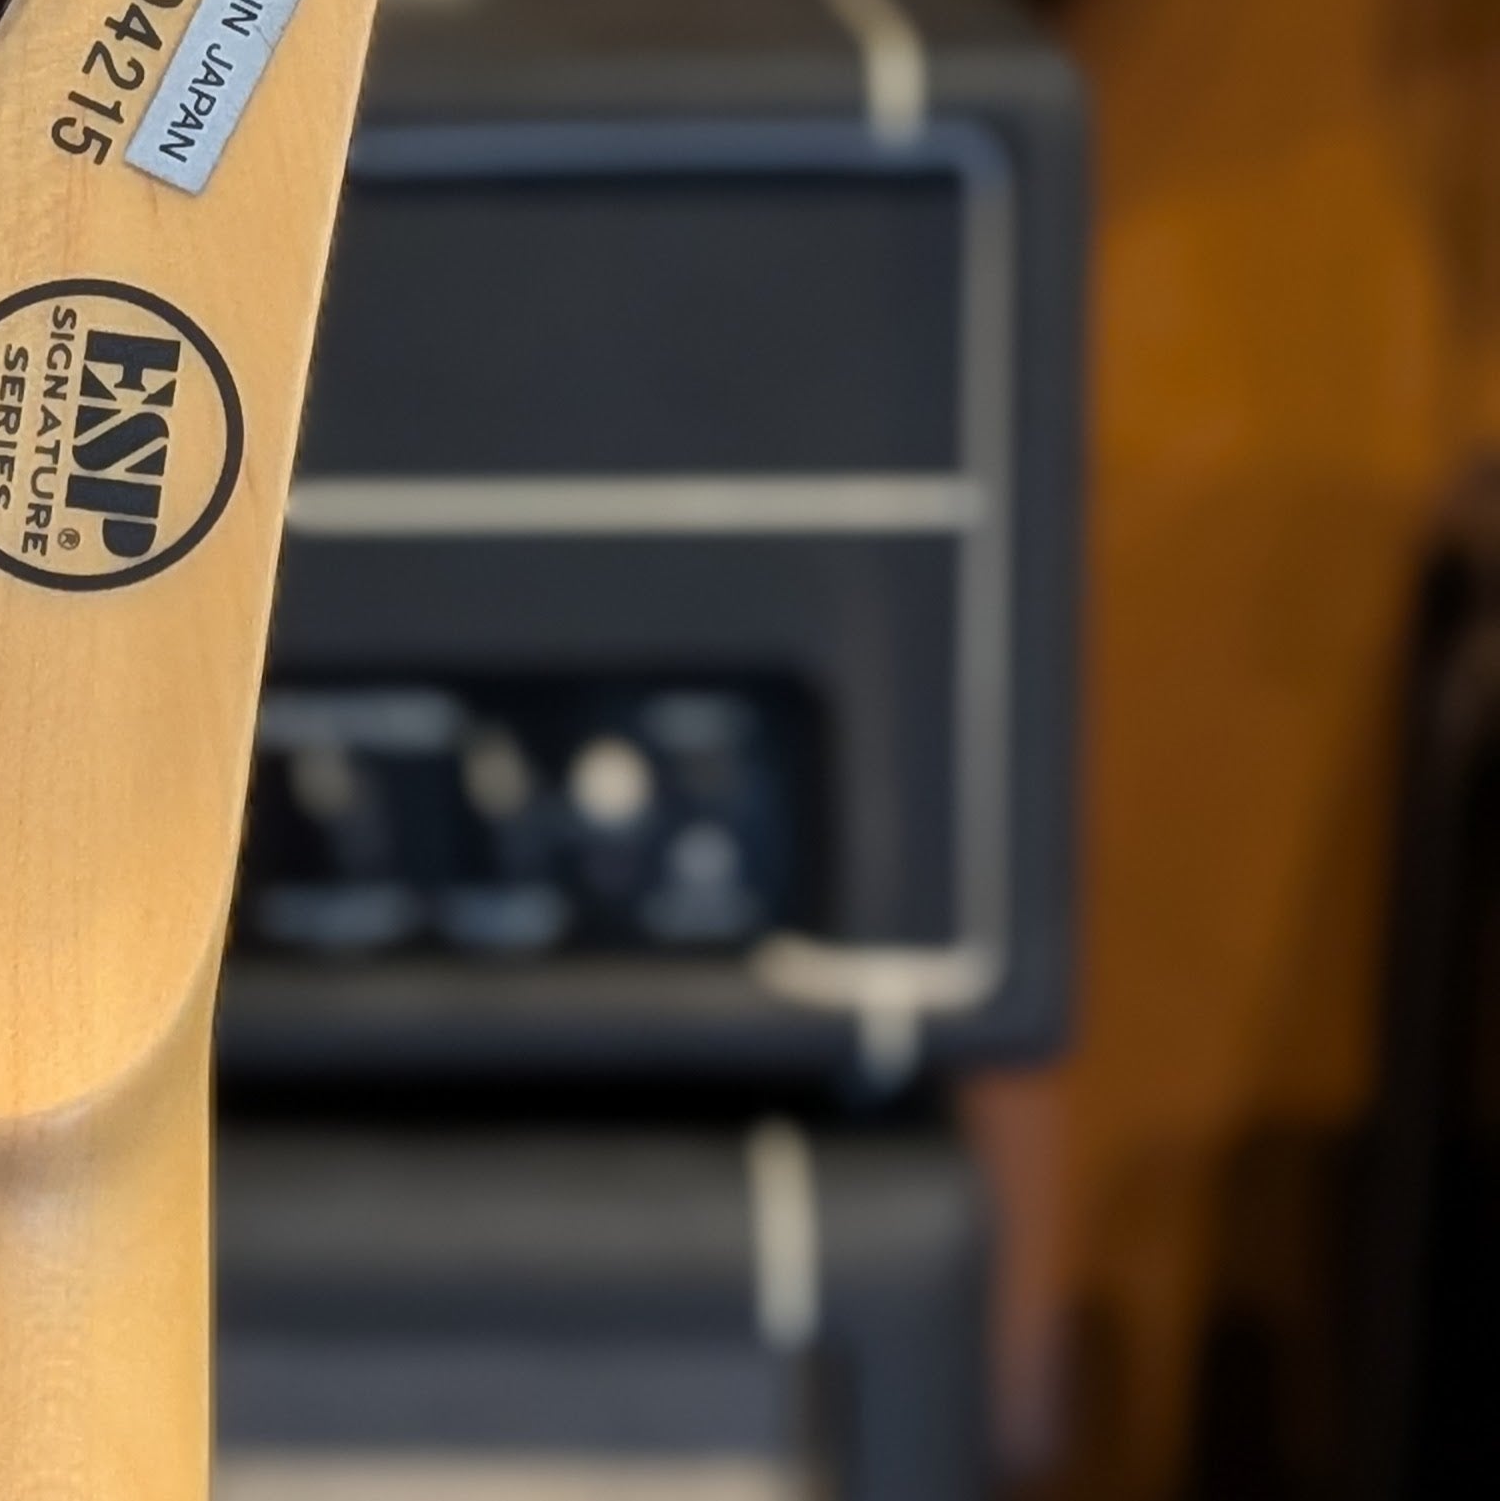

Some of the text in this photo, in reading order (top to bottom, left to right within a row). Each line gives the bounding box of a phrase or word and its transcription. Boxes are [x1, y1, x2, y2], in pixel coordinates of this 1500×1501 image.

[159, 43, 234, 163] JAPAN
[21, 305, 77, 556] SIGNATURE
[64, 329, 181, 558] ESP
